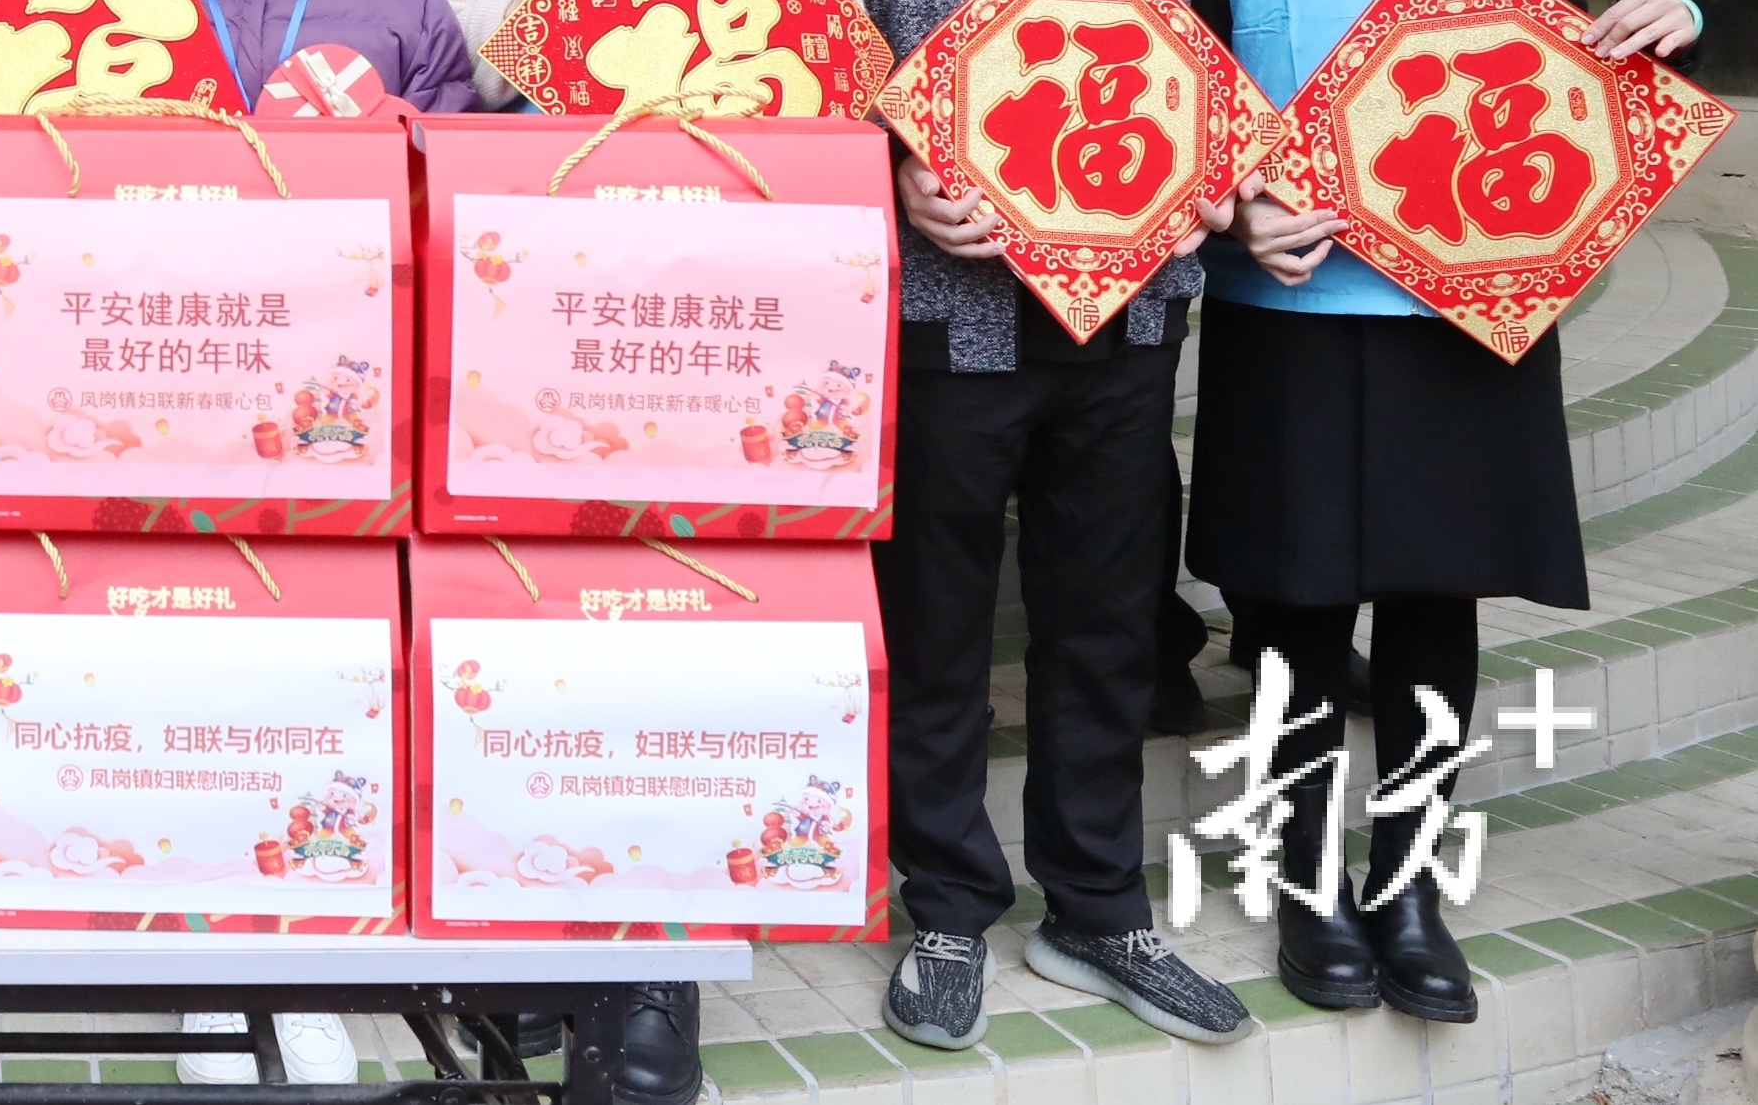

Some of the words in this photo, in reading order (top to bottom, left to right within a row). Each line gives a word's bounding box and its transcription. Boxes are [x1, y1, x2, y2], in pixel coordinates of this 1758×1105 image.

[980, 16, 1177, 218] 福
[1370, 38, 1596, 247] 福
[60, 292, 293, 331] 平安健康就是
[551, 291, 786, 332] 平安健康就是
[80, 337, 273, 375] 最好的年味
[569, 337, 764, 377] 最好的年味
[79, 389, 274, 411] 凤岗镇妇联新春暖心包
[567, 392, 763, 415] 凤岗镇妇联新春暖心包
[107, 585, 236, 611] 好吃才是好礼
[579, 588, 712, 613] 好吃才是好礼
[13, 721, 344, 757] 同心抗疫，妇联与你同在
[481, 729, 819, 761] 同心抗疫，妇联与你同在
[89, 764, 282, 794] 凤岗镇妇联慰问活动
[559, 775, 756, 799] 凤岗镇妇联慰问活动
